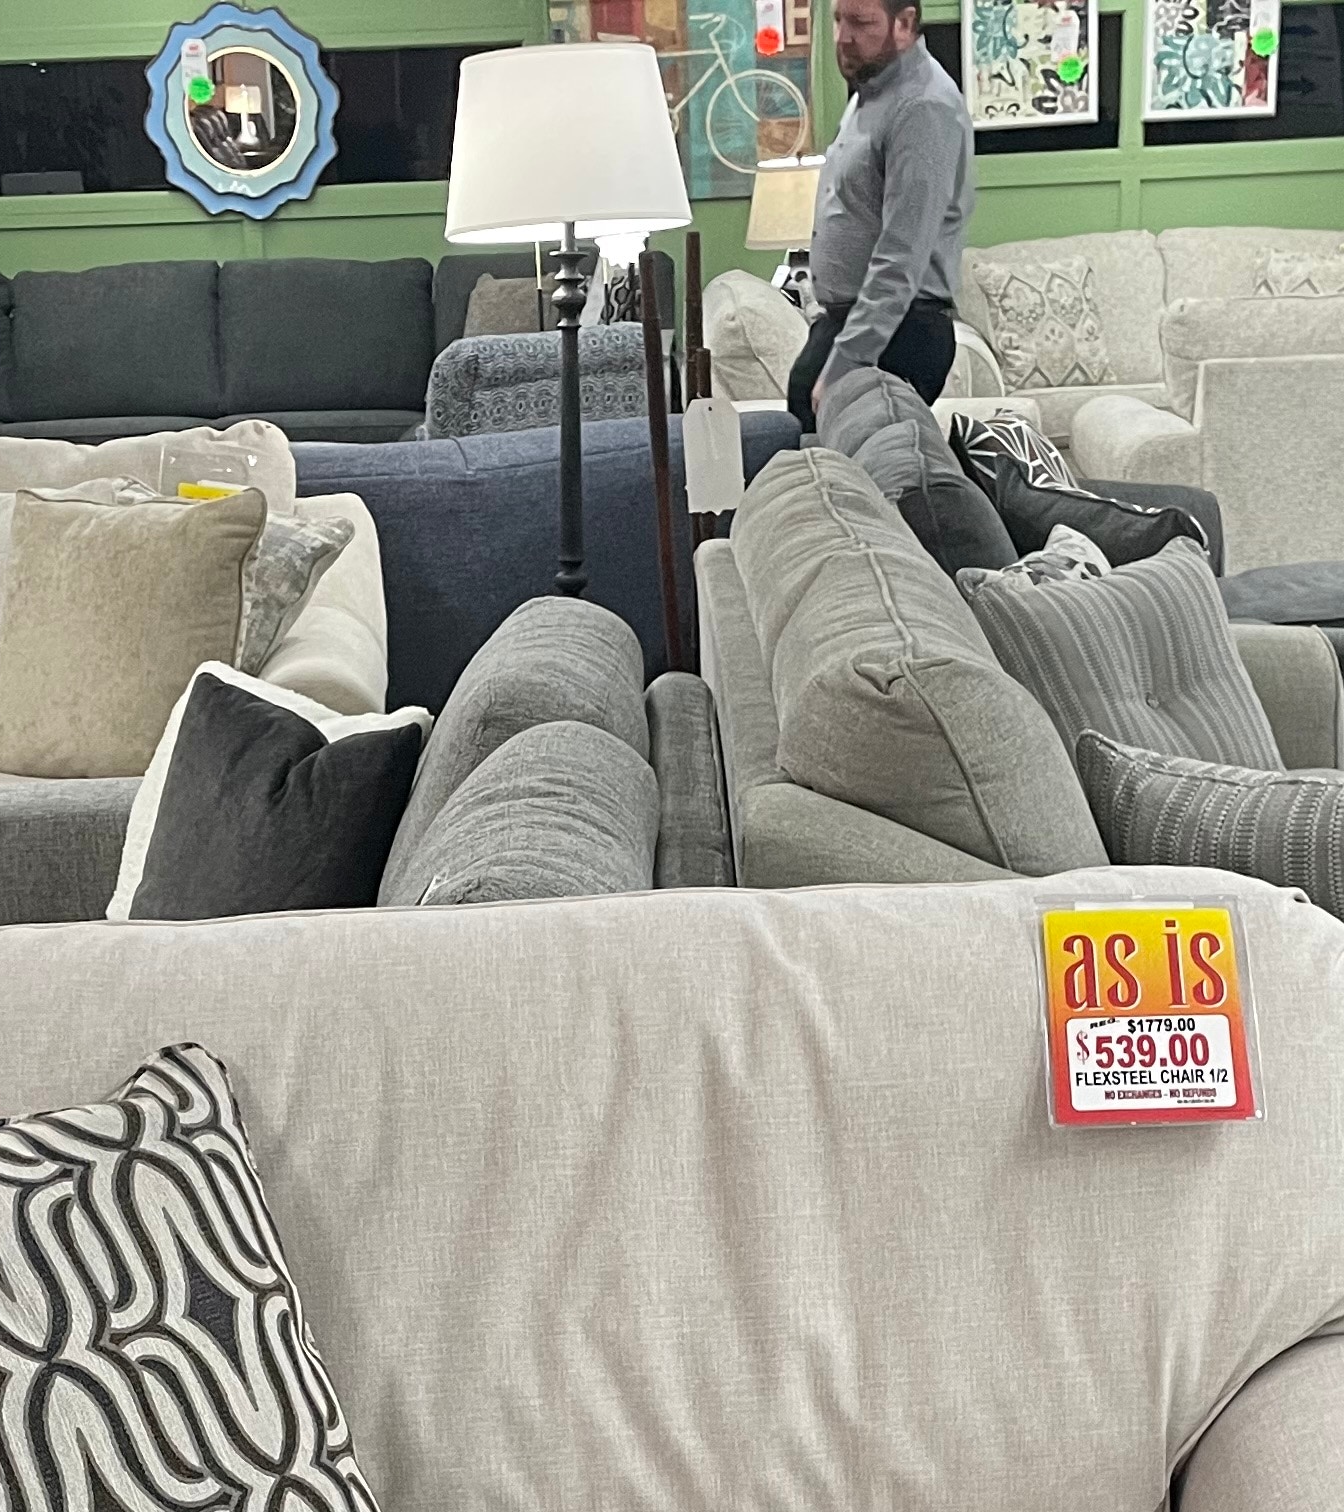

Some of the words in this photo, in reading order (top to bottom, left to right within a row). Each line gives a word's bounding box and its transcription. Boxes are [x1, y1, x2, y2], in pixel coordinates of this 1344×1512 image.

[1063, 933, 1140, 1010] as
[1164, 919, 1226, 1008] is
[1127, 1017, 1196, 1034] $1779.00
[1075, 1070, 1157, 1087] FLEXSTEEL
[1160, 1068, 1206, 1084] CHAIR
[1209, 1068, 1229, 1083] 1/2
[1104, 1089, 1116, 1100] NO
[1169, 1088, 1181, 1098] NO
